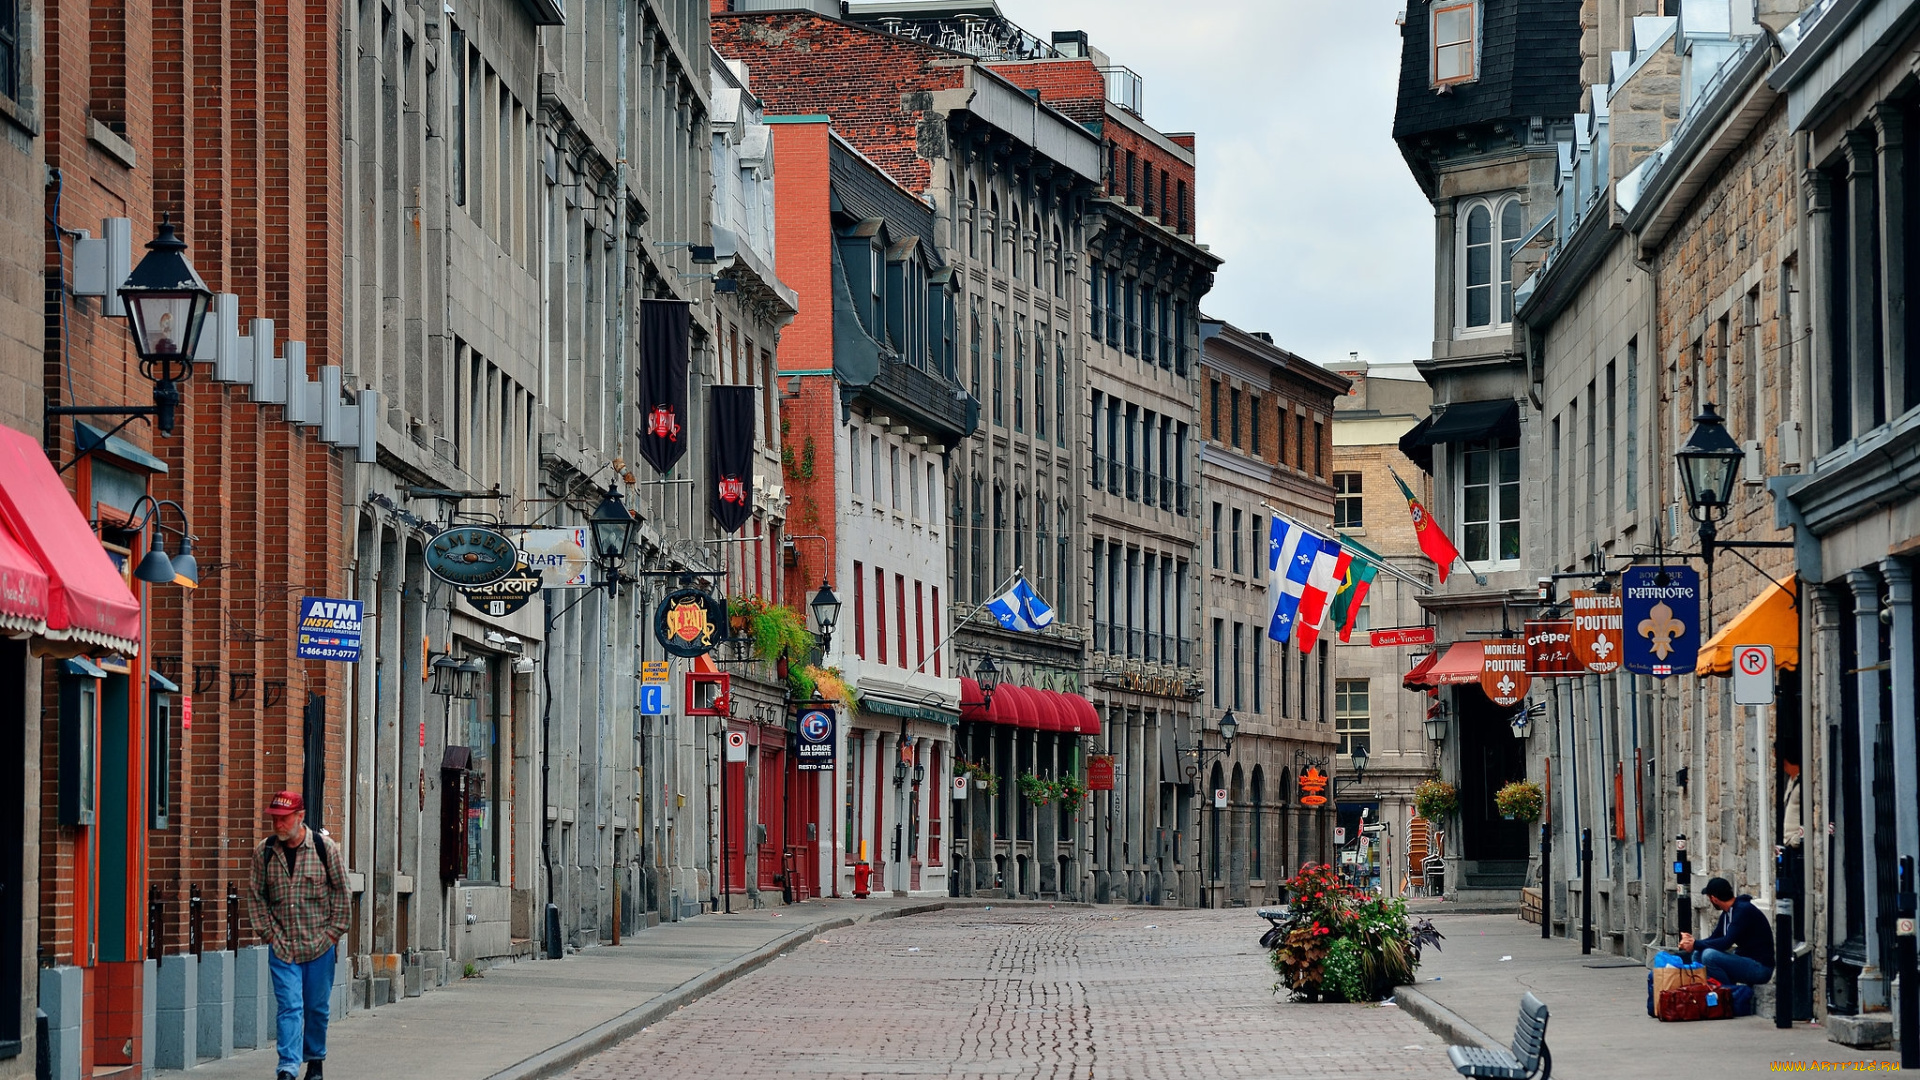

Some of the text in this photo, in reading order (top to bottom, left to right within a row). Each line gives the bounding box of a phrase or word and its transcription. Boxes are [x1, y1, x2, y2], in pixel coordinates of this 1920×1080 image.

[660, 413, 677, 436] PAUL
[728, 482, 744, 501] PAUL
[434, 531, 509, 558] AMBER
[1639, 571, 1683, 580] BOUQUE
[1628, 587, 1693, 598] PATRIOTE
[308, 601, 357, 620] ATM
[683, 609, 710, 640] PAUL
[1528, 631, 1571, 646] crêper
[300, 646, 357, 658] 1-866-837-0777
[1485, 659, 1526, 672] POUTINE
